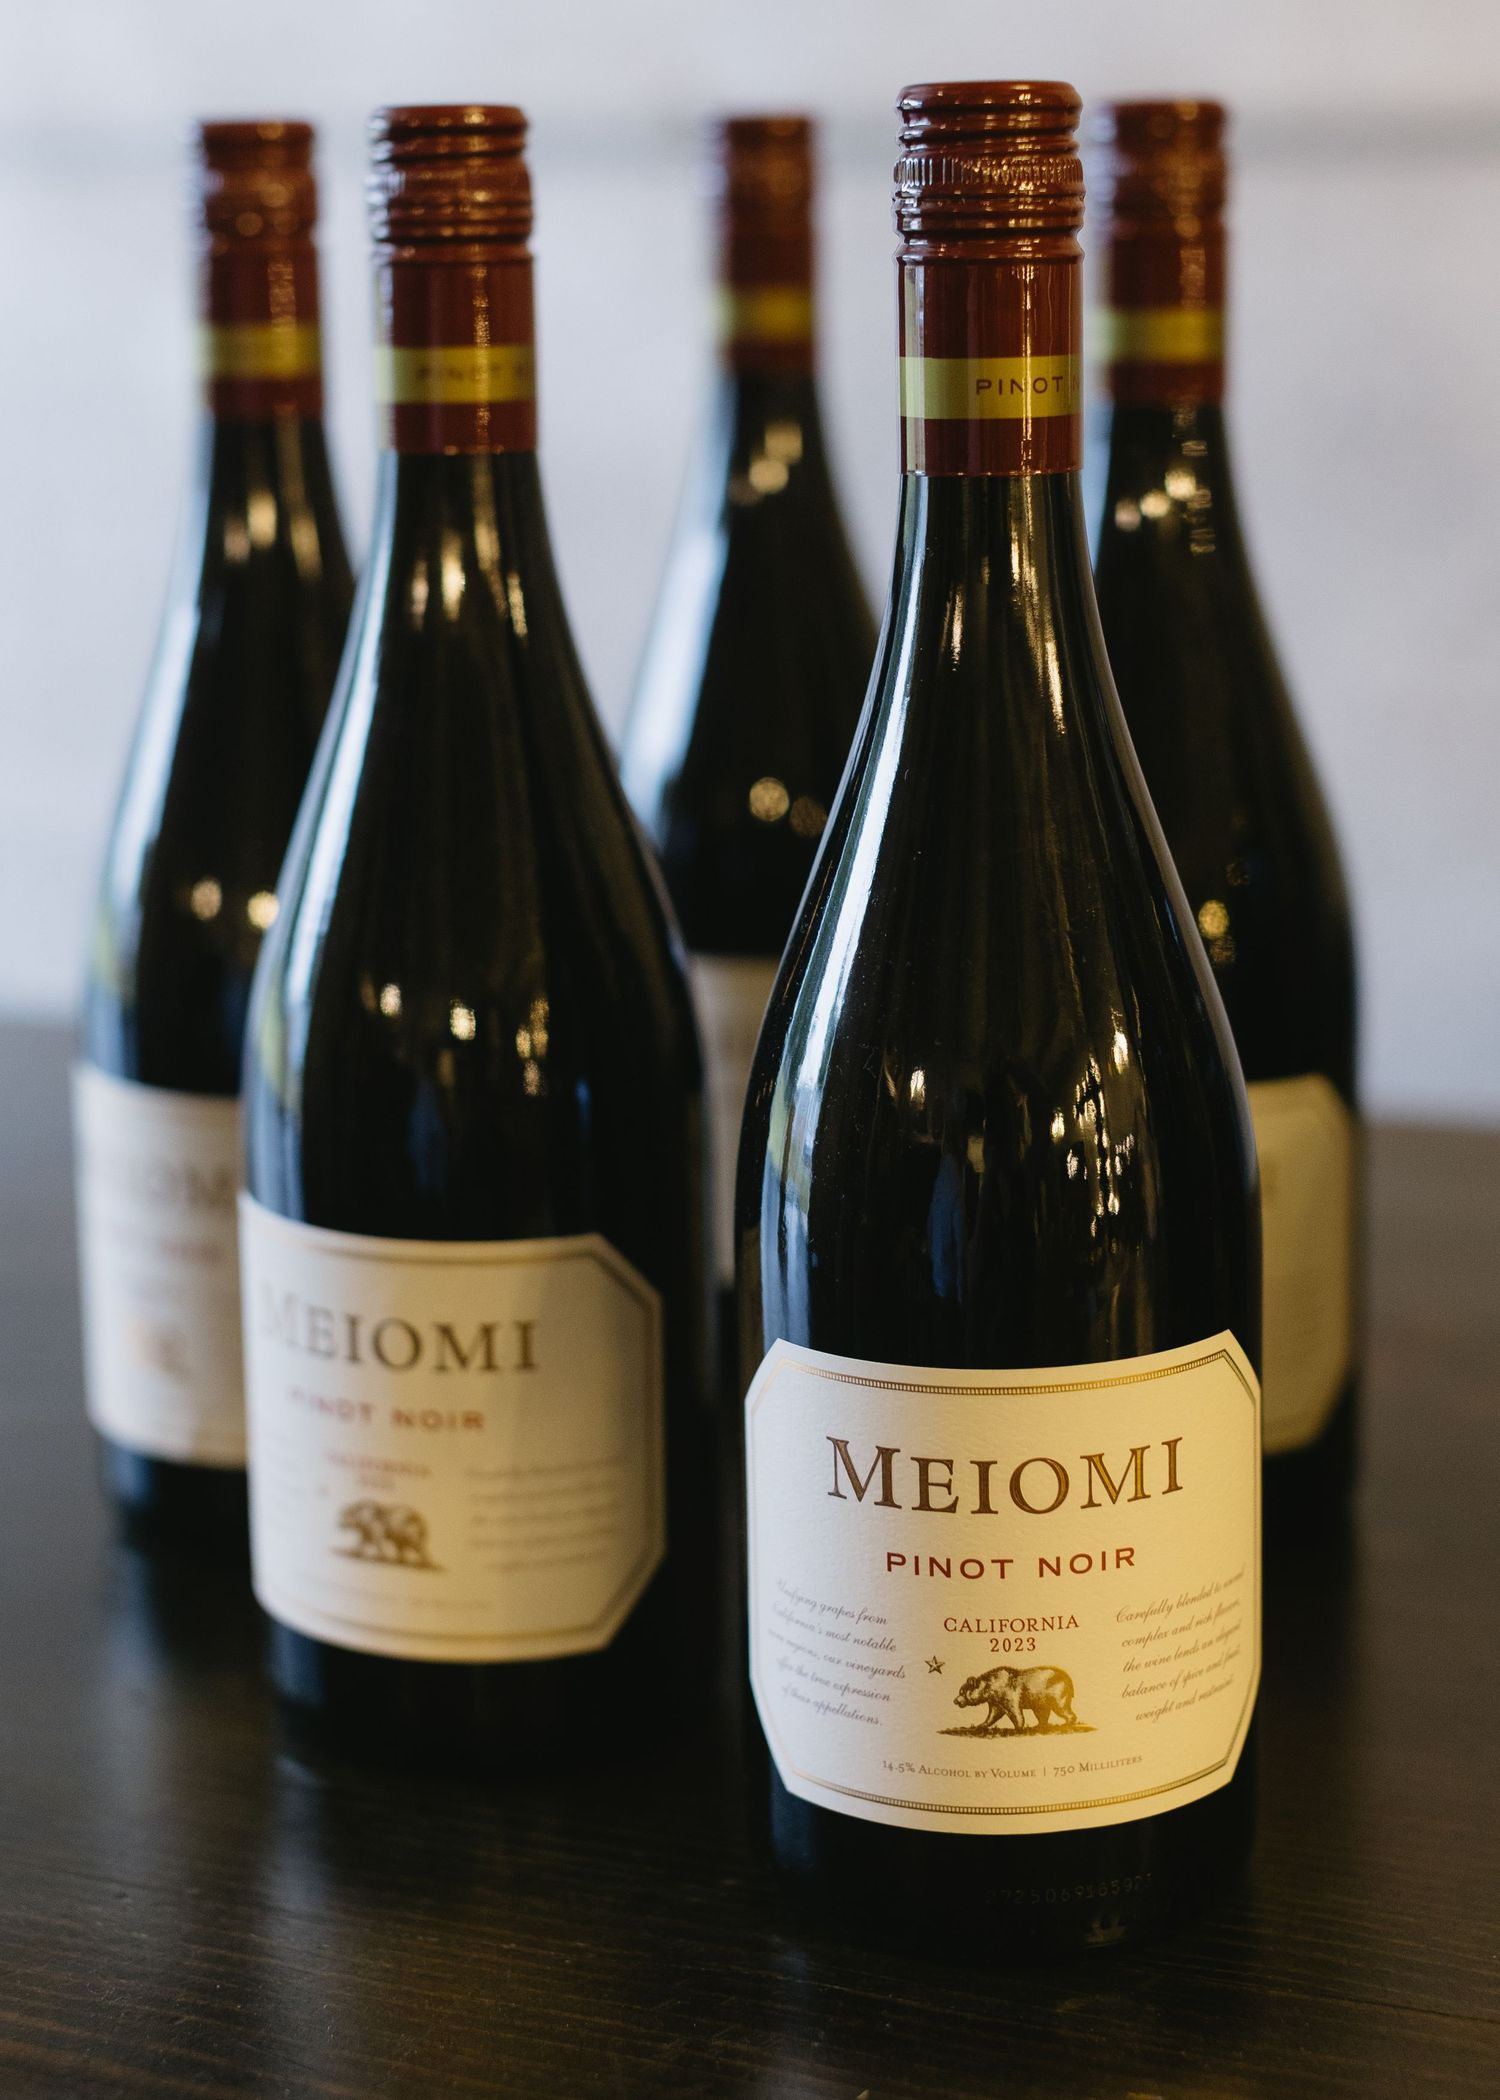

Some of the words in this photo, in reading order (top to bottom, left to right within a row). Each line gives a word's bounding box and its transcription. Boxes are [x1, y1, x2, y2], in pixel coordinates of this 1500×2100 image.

[976, 376, 1063, 395] PINOT
[826, 1435, 1183, 1515] MEIOMI
[886, 1551, 1014, 1580] PINOT
[1039, 1547, 1137, 1578] NOIR
[820, 1601, 855, 1619] grapes
[856, 1608, 888, 1625] from
[1116, 1598, 1174, 1624] Carefully
[1176, 1582, 1214, 1609] blended
[943, 1615, 1080, 1634] CALIFORNIA
[1122, 1625, 1169, 1649] complex
[1171, 1615, 1195, 1636] and
[825, 1628, 850, 1643] most
[853, 1636, 896, 1652] notable
[990, 1638, 1036, 1653] 2023
[824, 1654, 842, 1665] our
[846, 1658, 906, 1680] vineyards
[1123, 1657, 1142, 1673] the
[1144, 1653, 1171, 1668] wine
[833, 1682, 891, 1702] expression
[1121, 1680, 1167, 1699] balance
[1169, 1669, 1184, 1692] of
[813, 1699, 883, 1726] appellations.
[1136, 1699, 1175, 1724] weight
[1176, 1687, 1197, 1710] and
[1053, 1766, 1075, 1778] 750
